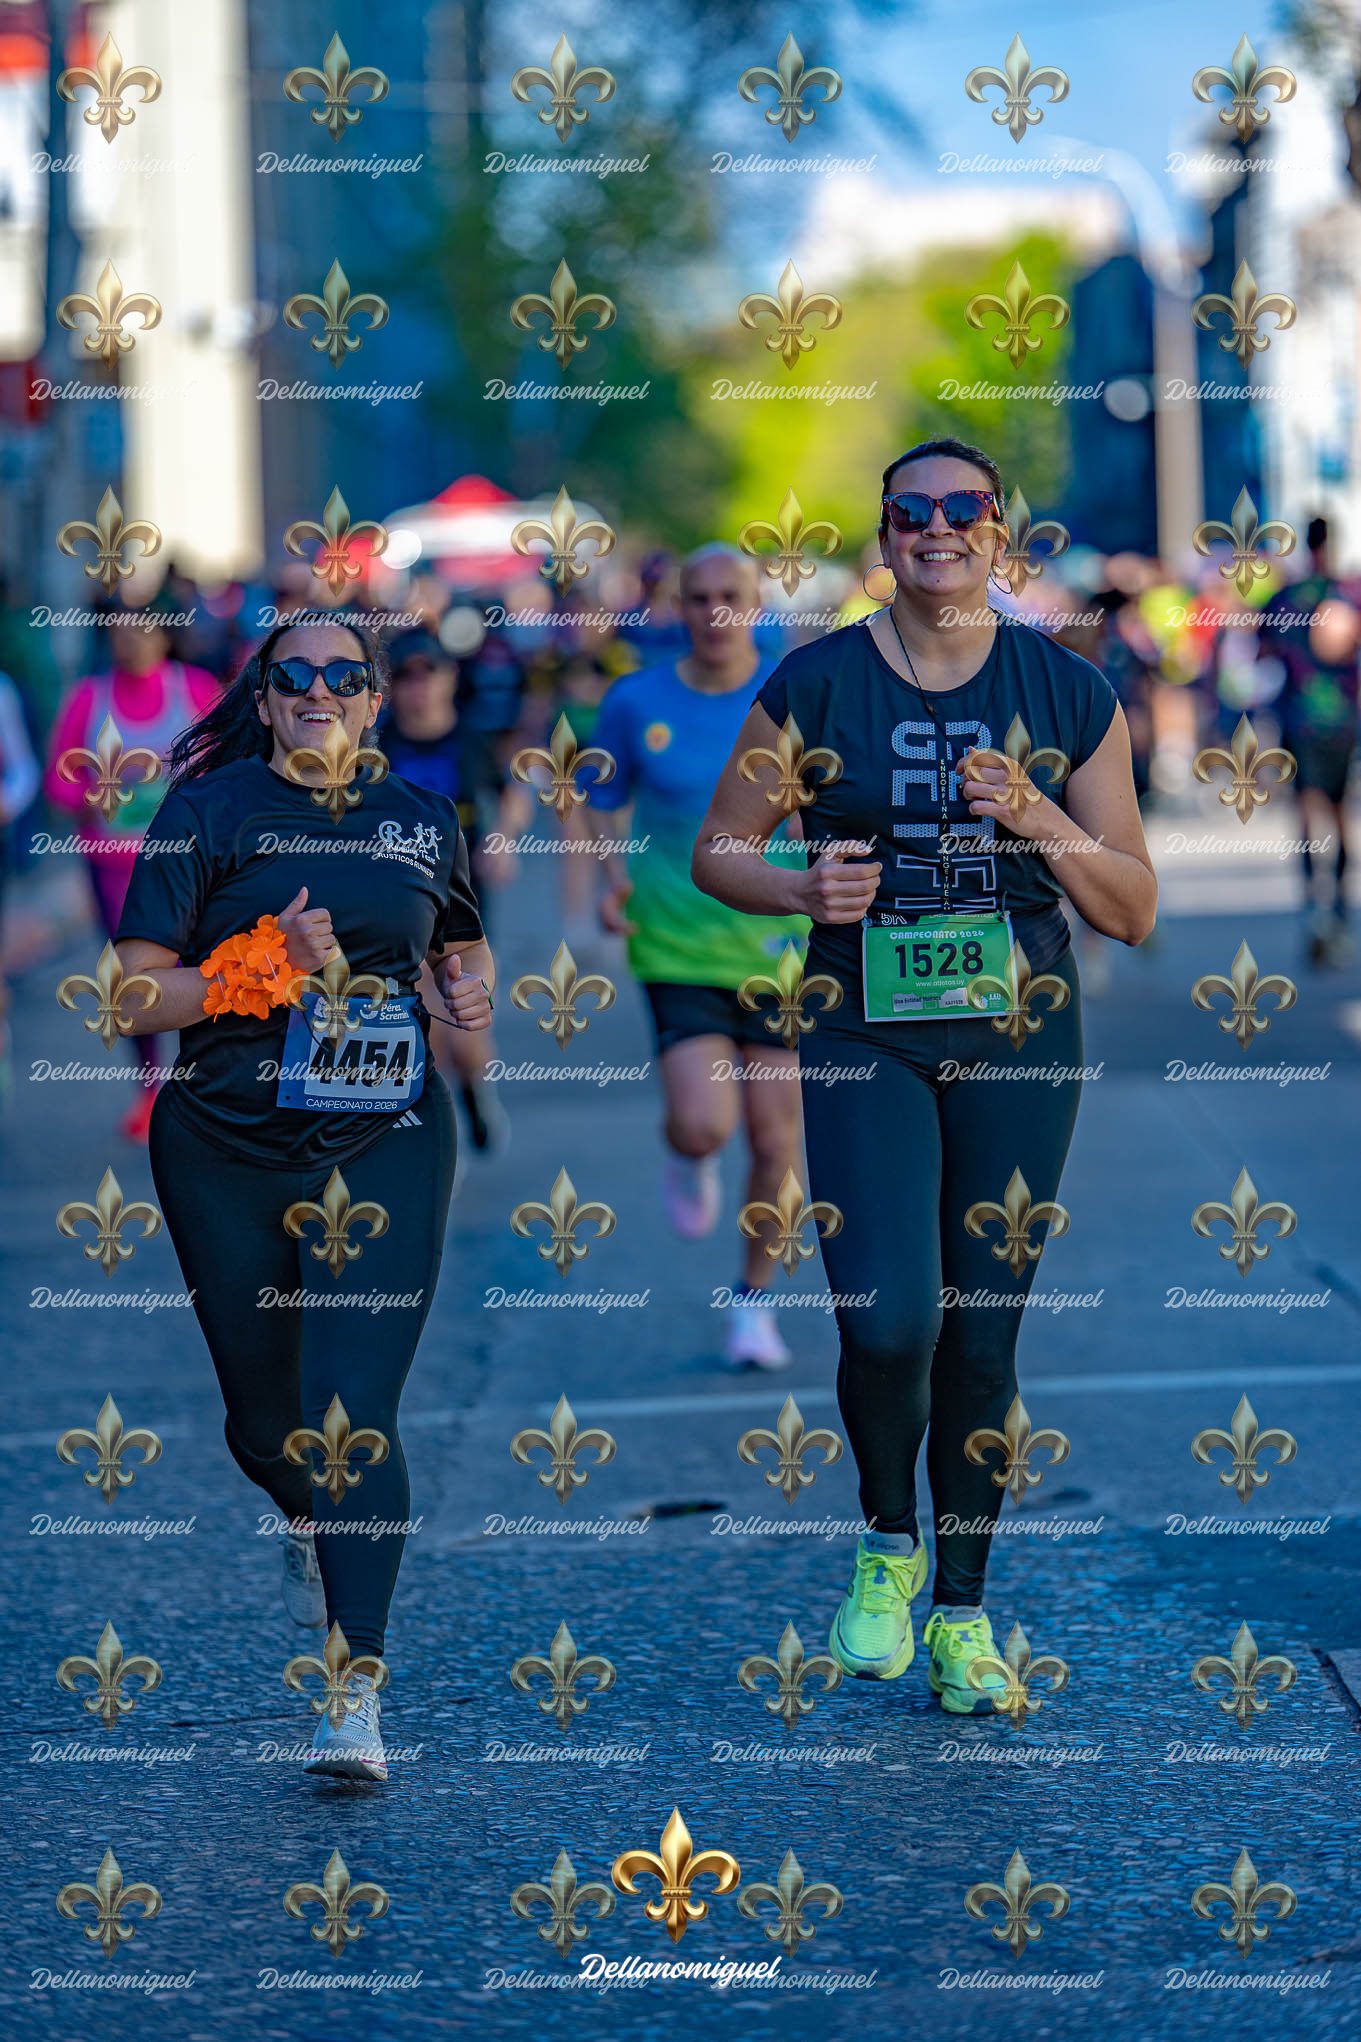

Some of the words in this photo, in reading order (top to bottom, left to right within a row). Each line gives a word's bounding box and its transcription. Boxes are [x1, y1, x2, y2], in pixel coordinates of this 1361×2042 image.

[940, 758, 948, 820] ENDORFINA
[889, 931, 957, 940] CAMPEONATO
[895, 941, 984, 978] 1528
[311, 1037, 410, 1087] 4454
[306, 1098, 372, 1110] CAMPEONATO
[374, 1101, 398, 1110] 2026
